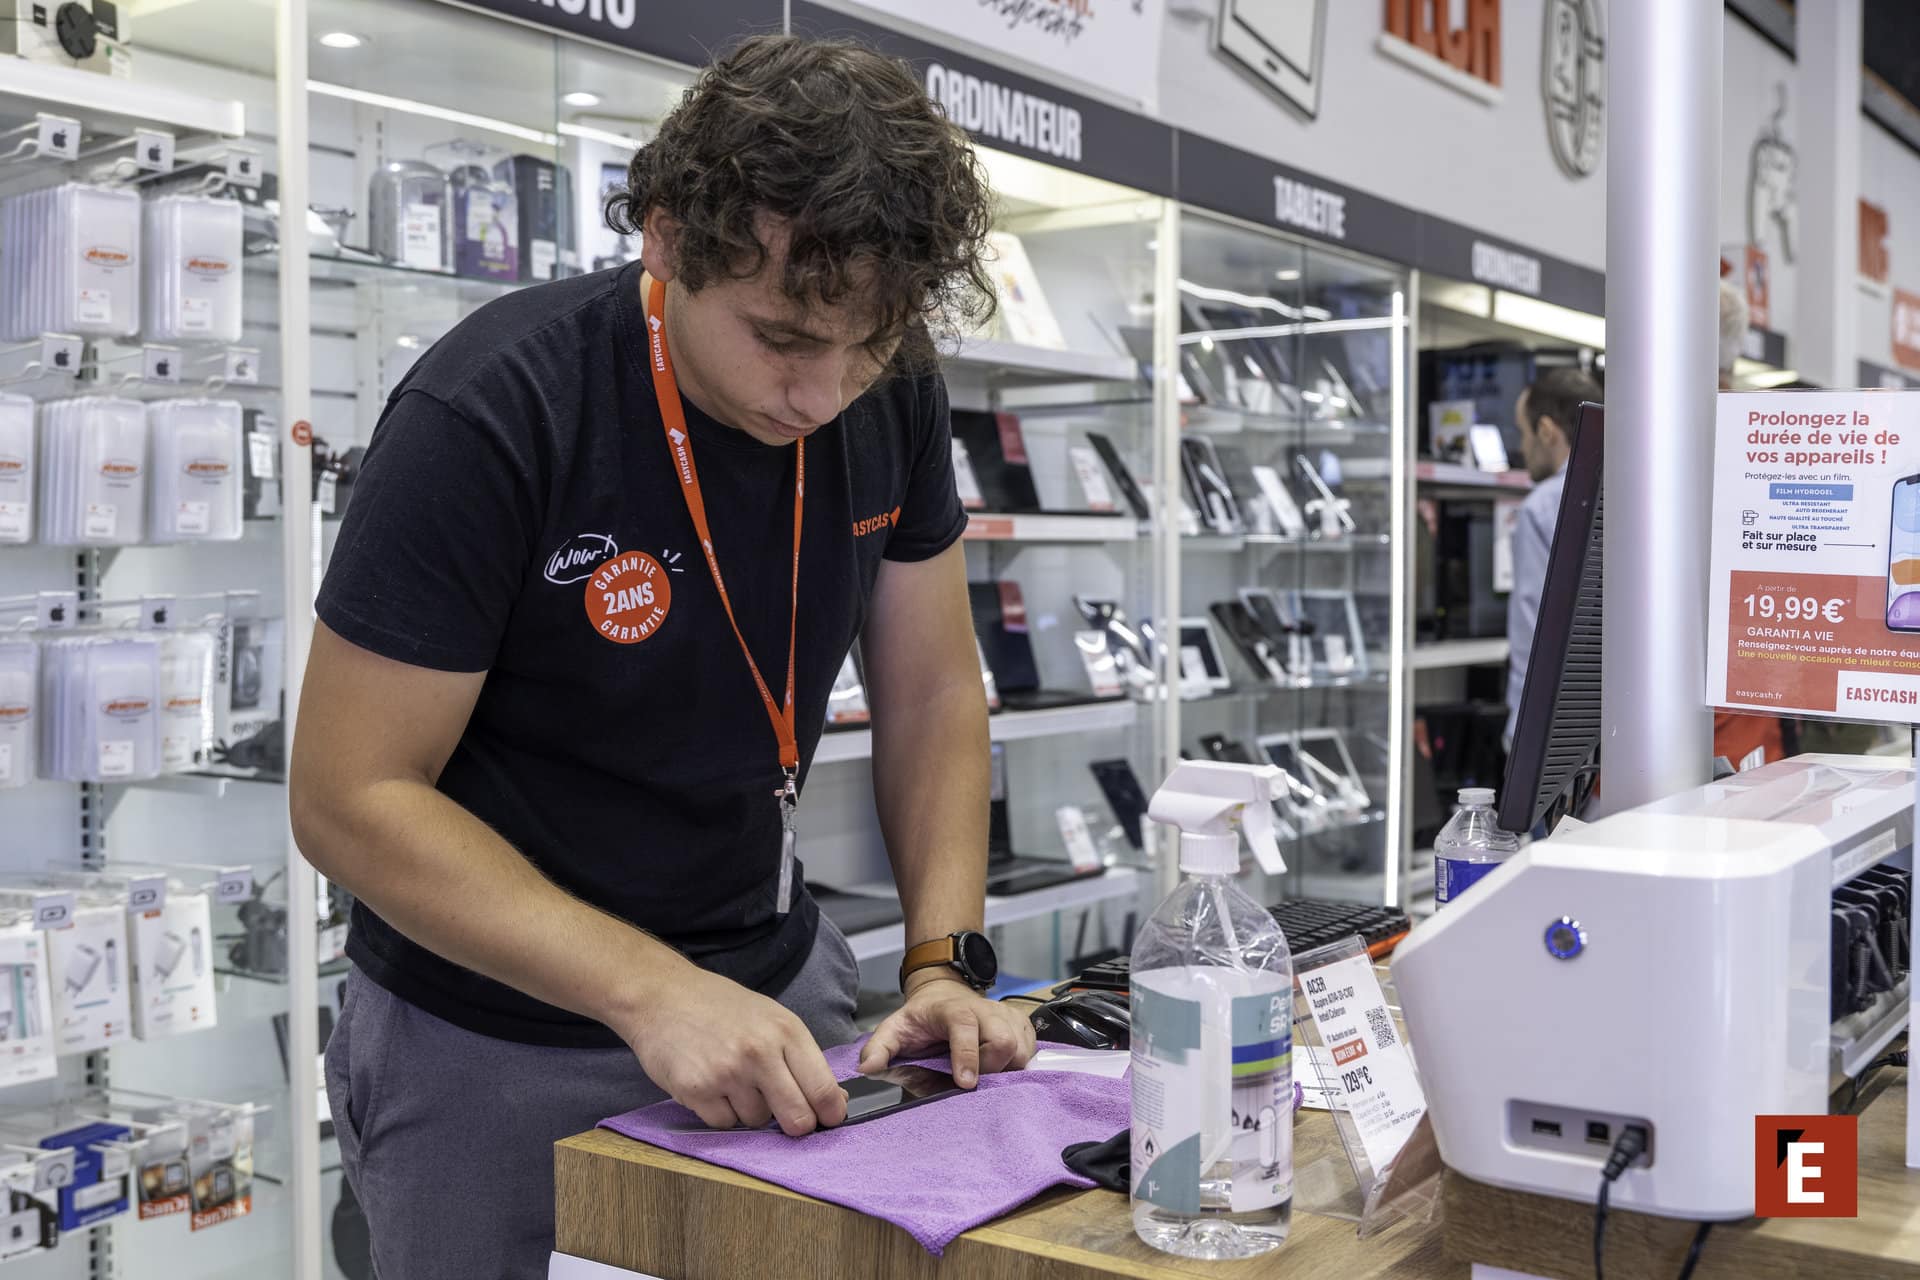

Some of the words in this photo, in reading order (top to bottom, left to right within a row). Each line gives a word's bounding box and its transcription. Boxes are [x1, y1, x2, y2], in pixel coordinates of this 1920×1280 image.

[926, 63, 1082, 162] ORDINATEUR
[1274, 175, 1345, 239] TABLETTE
[652, 333, 665, 372] EASYCASH
[1748, 411, 1847, 429] Prolongez
[1852, 411, 1870, 426] la
[1747, 429, 1802, 445] durée
[1807, 430, 1833, 446] de
[1838, 430, 1868, 446] vie
[1874, 430, 1901, 446] de
[676, 446, 694, 484] EASYCASH
[1746, 451, 1779, 464] vos
[1784, 449, 1875, 467] appareils
[1881, 450, 1887, 464] !
[1744, 472, 1796, 482] Protégez-les
[1833, 472, 1852, 481] film.
[1794, 488, 1833, 496] HYDROGEL
[852, 512, 889, 537] ASYCAS
[1742, 530, 1763, 541] Fait
[1766, 532, 1783, 541] sur
[1786, 531, 1817, 544] place
[548, 534, 612, 576] Wow!
[1742, 541, 1753, 550] et
[1756, 542, 1773, 551] sur
[1775, 542, 1818, 552] mesure
[594, 556, 657, 590] GARANTIE
[603, 581, 655, 615] 2ANS
[1764, 585, 1785, 593] partir
[601, 606, 665, 640] GARANTIE
[1747, 626, 1800, 639] GARANTI
[1802, 631, 1811, 640] A
[1814, 631, 1834, 641] VIE
[1738, 640, 1817, 653] Renseignez-vous
[1819, 644, 1852, 655] auprès
[1854, 646, 1868, 655] de
[1870, 648, 1897, 657] notre
[1737, 650, 1755, 659] Une
[1758, 652, 1797, 662] nouvelle
[1799, 654, 1842, 664] occasion
[1844, 657, 1857, 665] de
[1860, 658, 1890, 667] mieux
[1736, 689, 1783, 700] easycash.fr
[1846, 687, 1917, 704] EASYCASH
[1306, 976, 1326, 995] ACER
[193, 1200, 249, 1228] SanDisk
